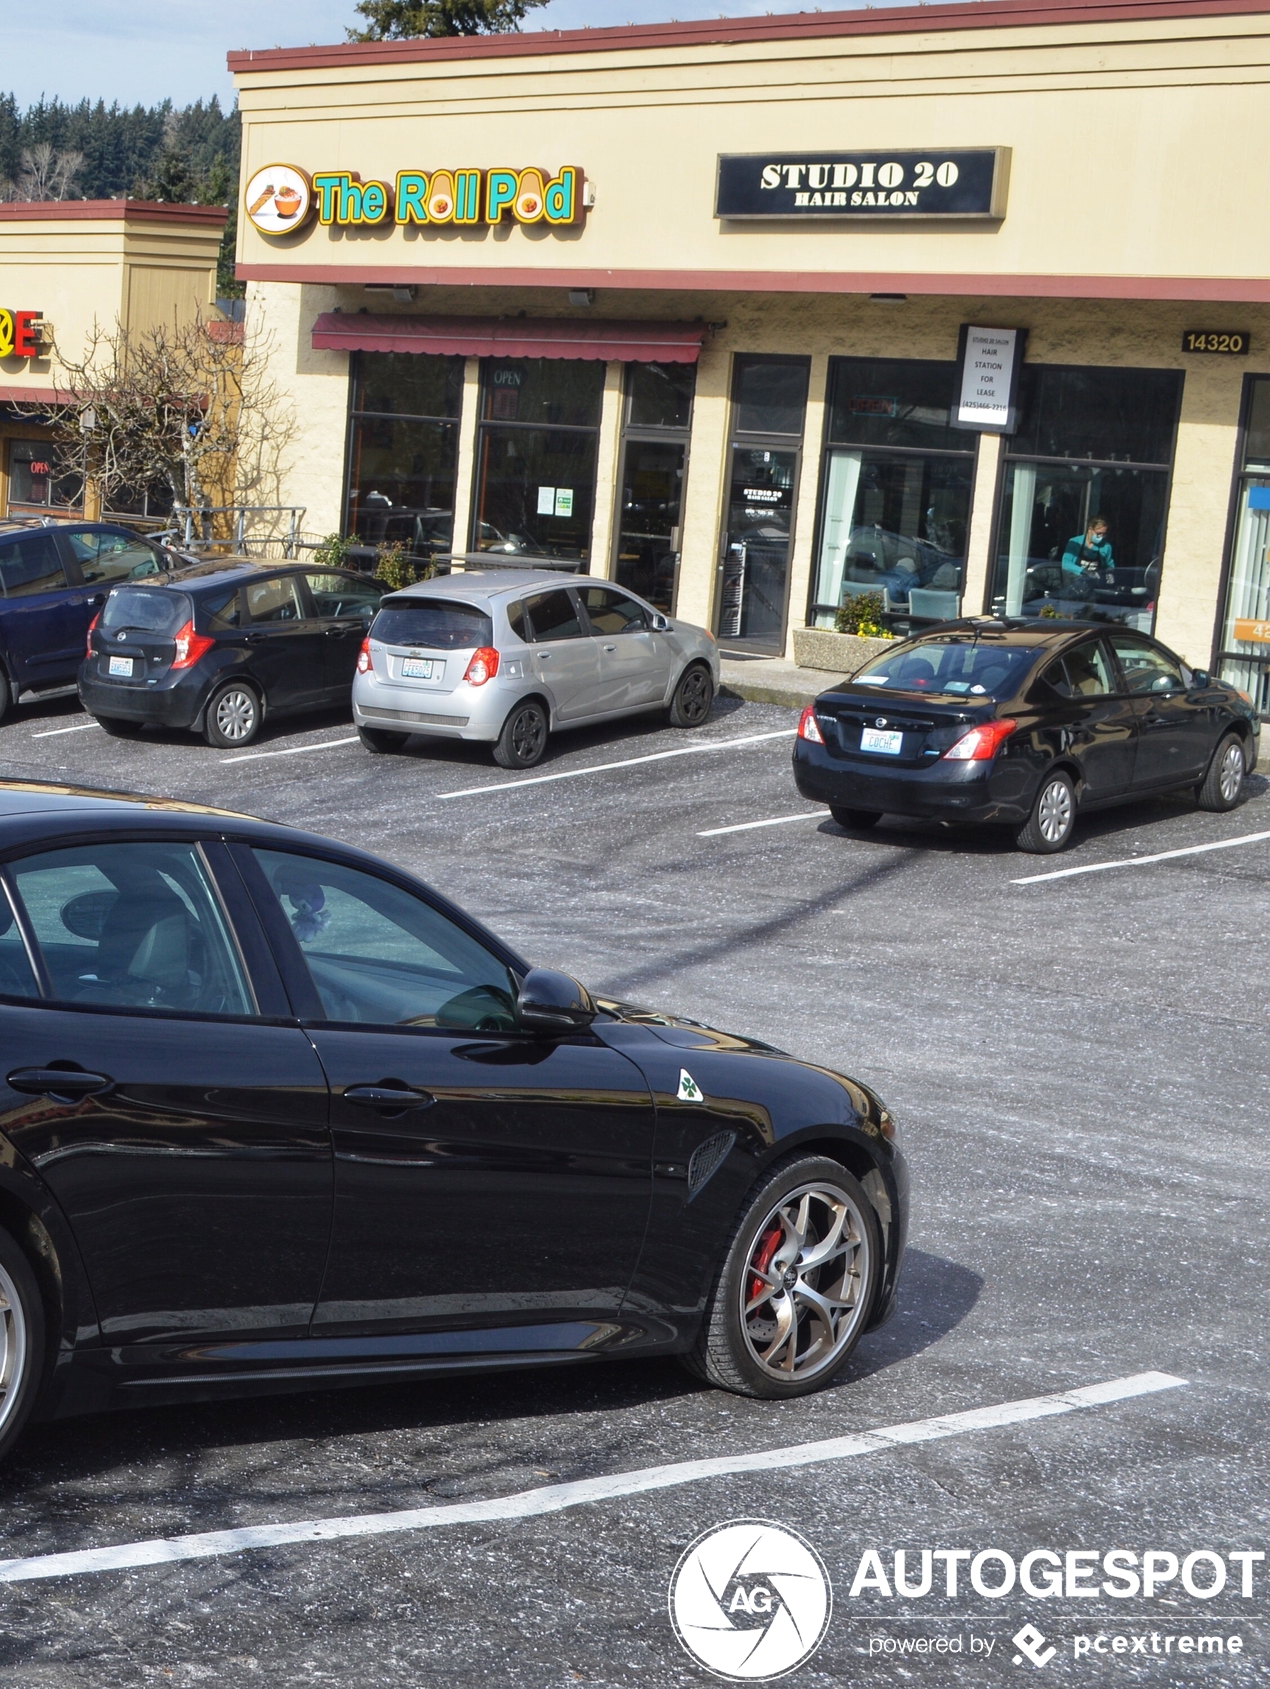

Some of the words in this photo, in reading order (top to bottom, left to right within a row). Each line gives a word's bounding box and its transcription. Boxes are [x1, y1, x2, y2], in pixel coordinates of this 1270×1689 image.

[760, 162, 905, 189] STUDIO
[912, 161, 960, 188] 20
[314, 171, 388, 223] The
[395, 168, 480, 225] Roll
[485, 165, 578, 224] Pod
[794, 192, 848, 206] HAIR
[850, 191, 920, 206] SALON
[1187, 334, 1243, 352] 14320
[981, 348, 998, 356] HAIR
[974, 361, 1003, 370] STATION
[494, 369, 522, 385] OPEN
[980, 375, 994, 383] FOR
[976, 389, 996, 397] LEASE
[30, 461, 49, 474] OPEN
[868, 736, 894, 749] COCHE
